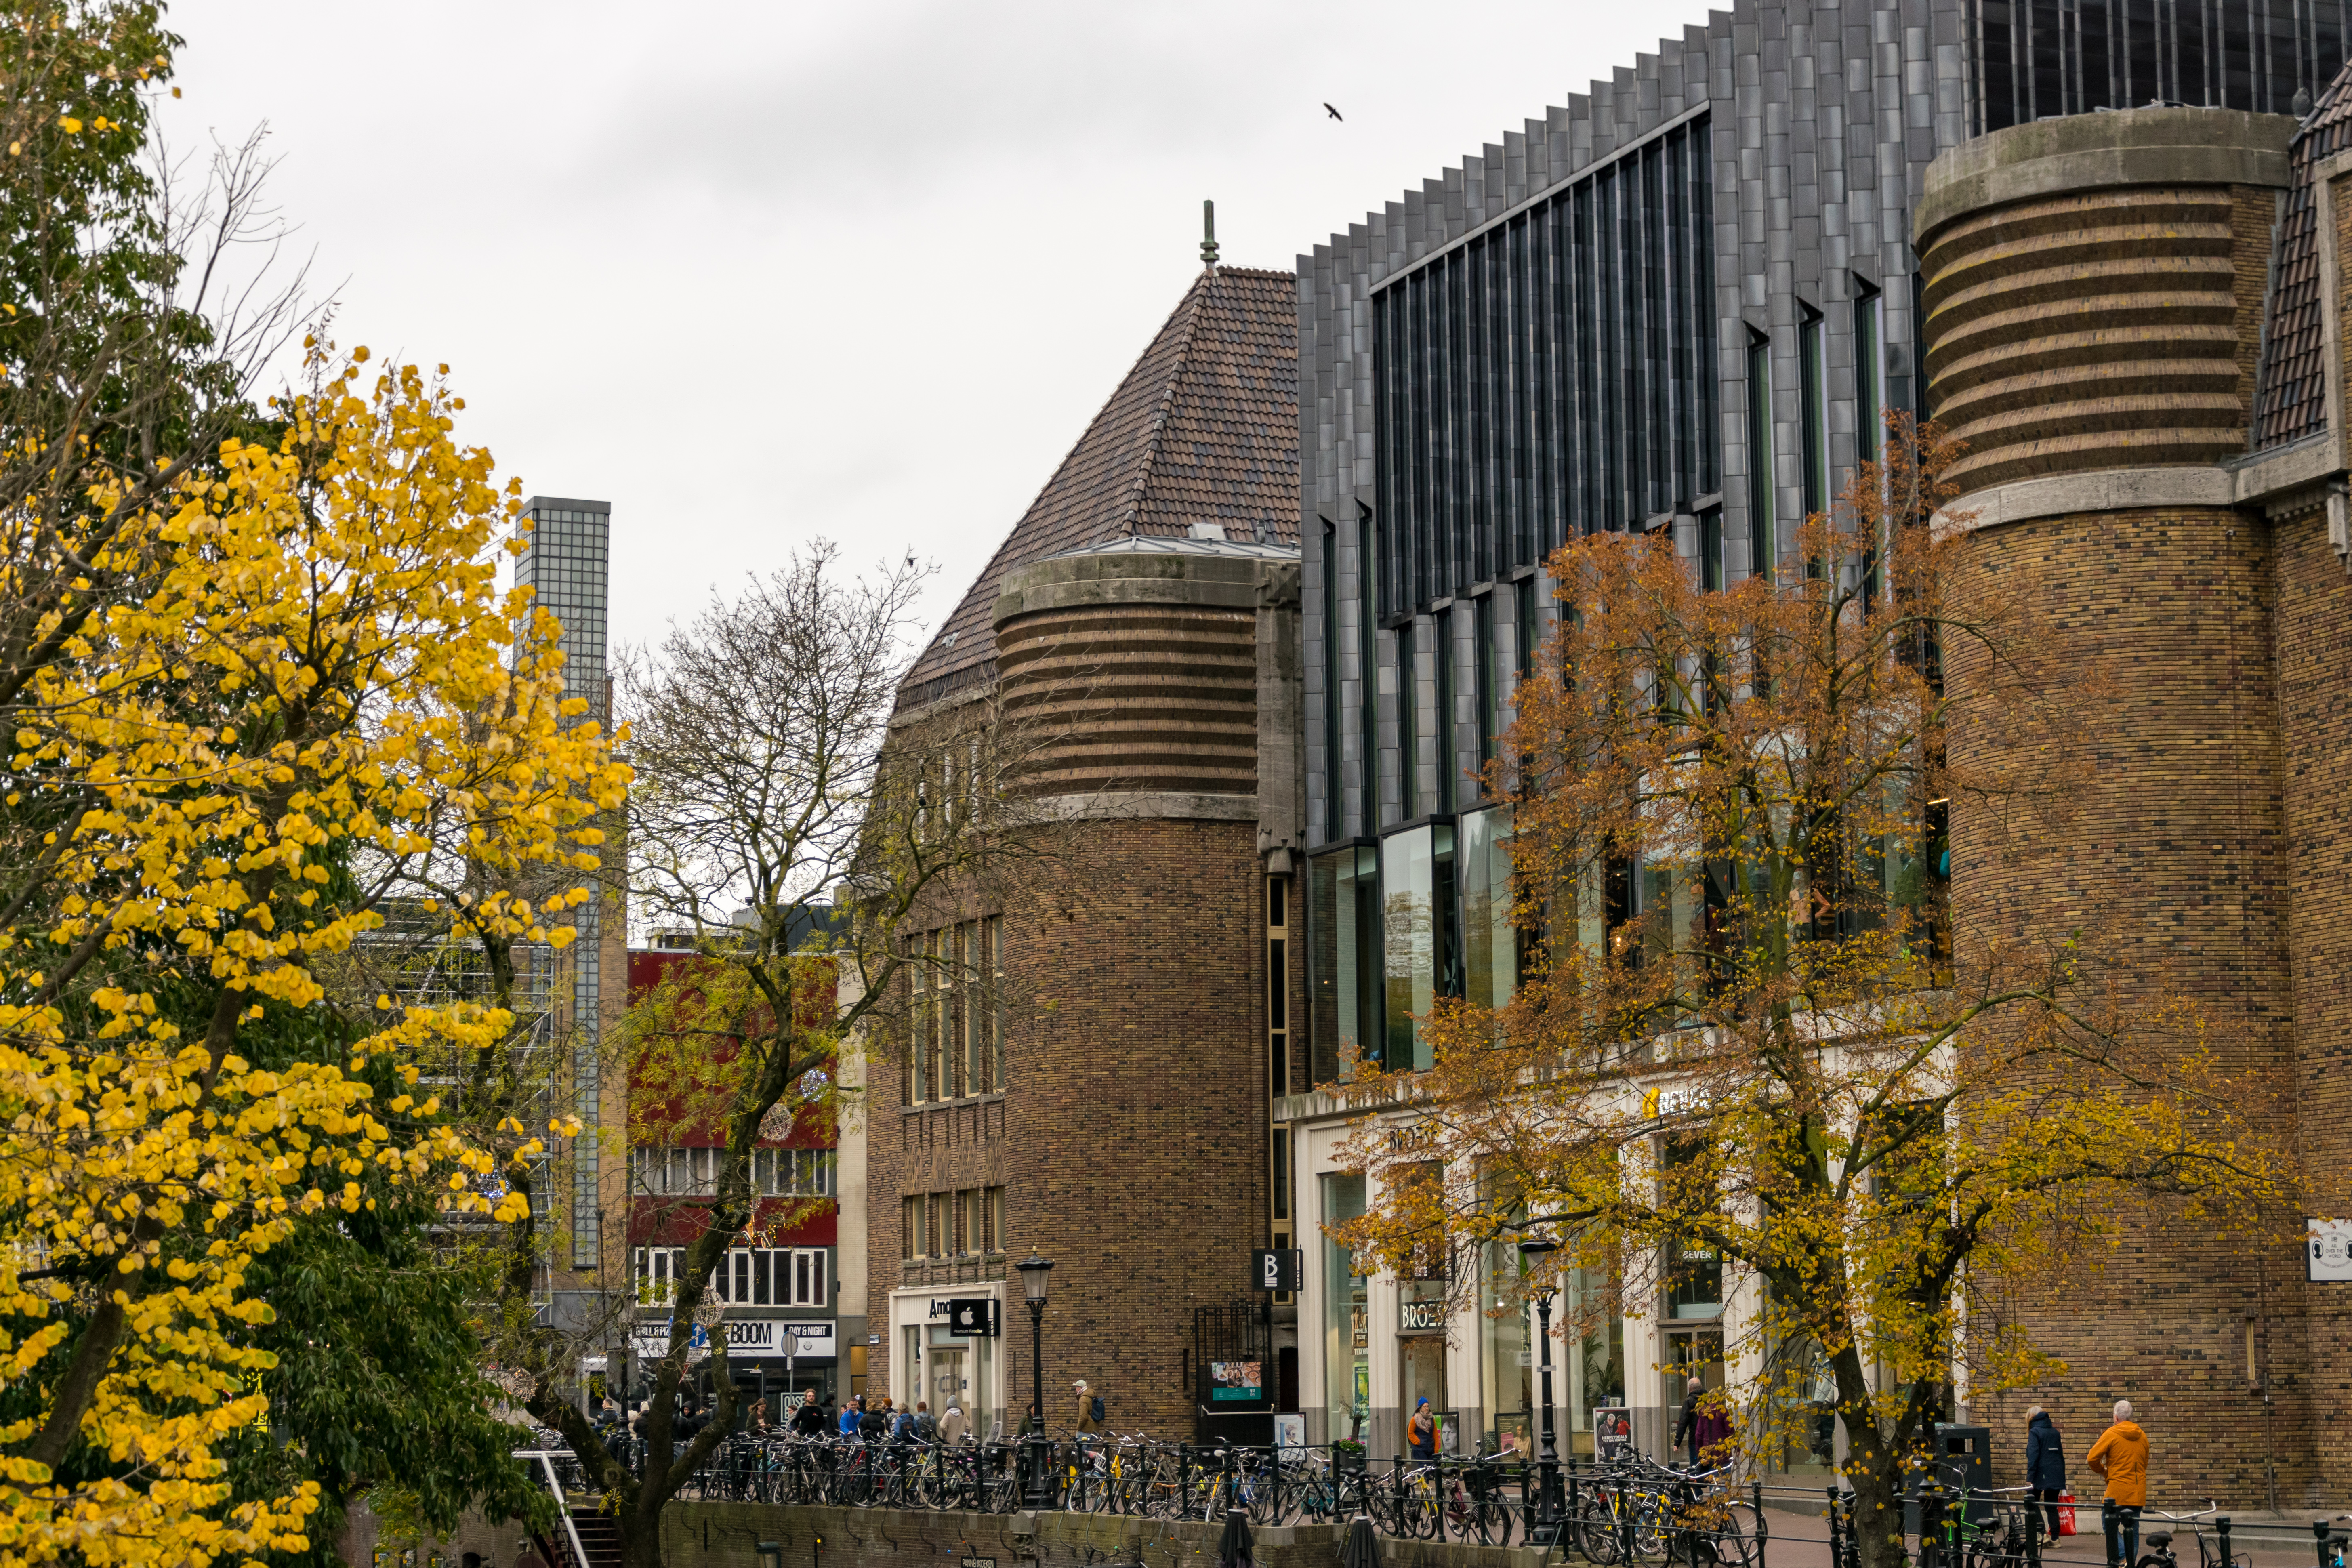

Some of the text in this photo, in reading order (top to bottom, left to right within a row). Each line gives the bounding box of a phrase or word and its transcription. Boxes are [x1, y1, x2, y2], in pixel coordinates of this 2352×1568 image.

[1390, 1125, 1438, 1151] BROE
[1402, 1304, 1447, 1328] BROES
[654, 1327, 659, 1336] &
[660, 1326, 669, 1336] PIZ
[789, 1326, 826, 1336] DAY & NIGHT
[962, 1559, 994, 1568] PANNENKOEKEN
